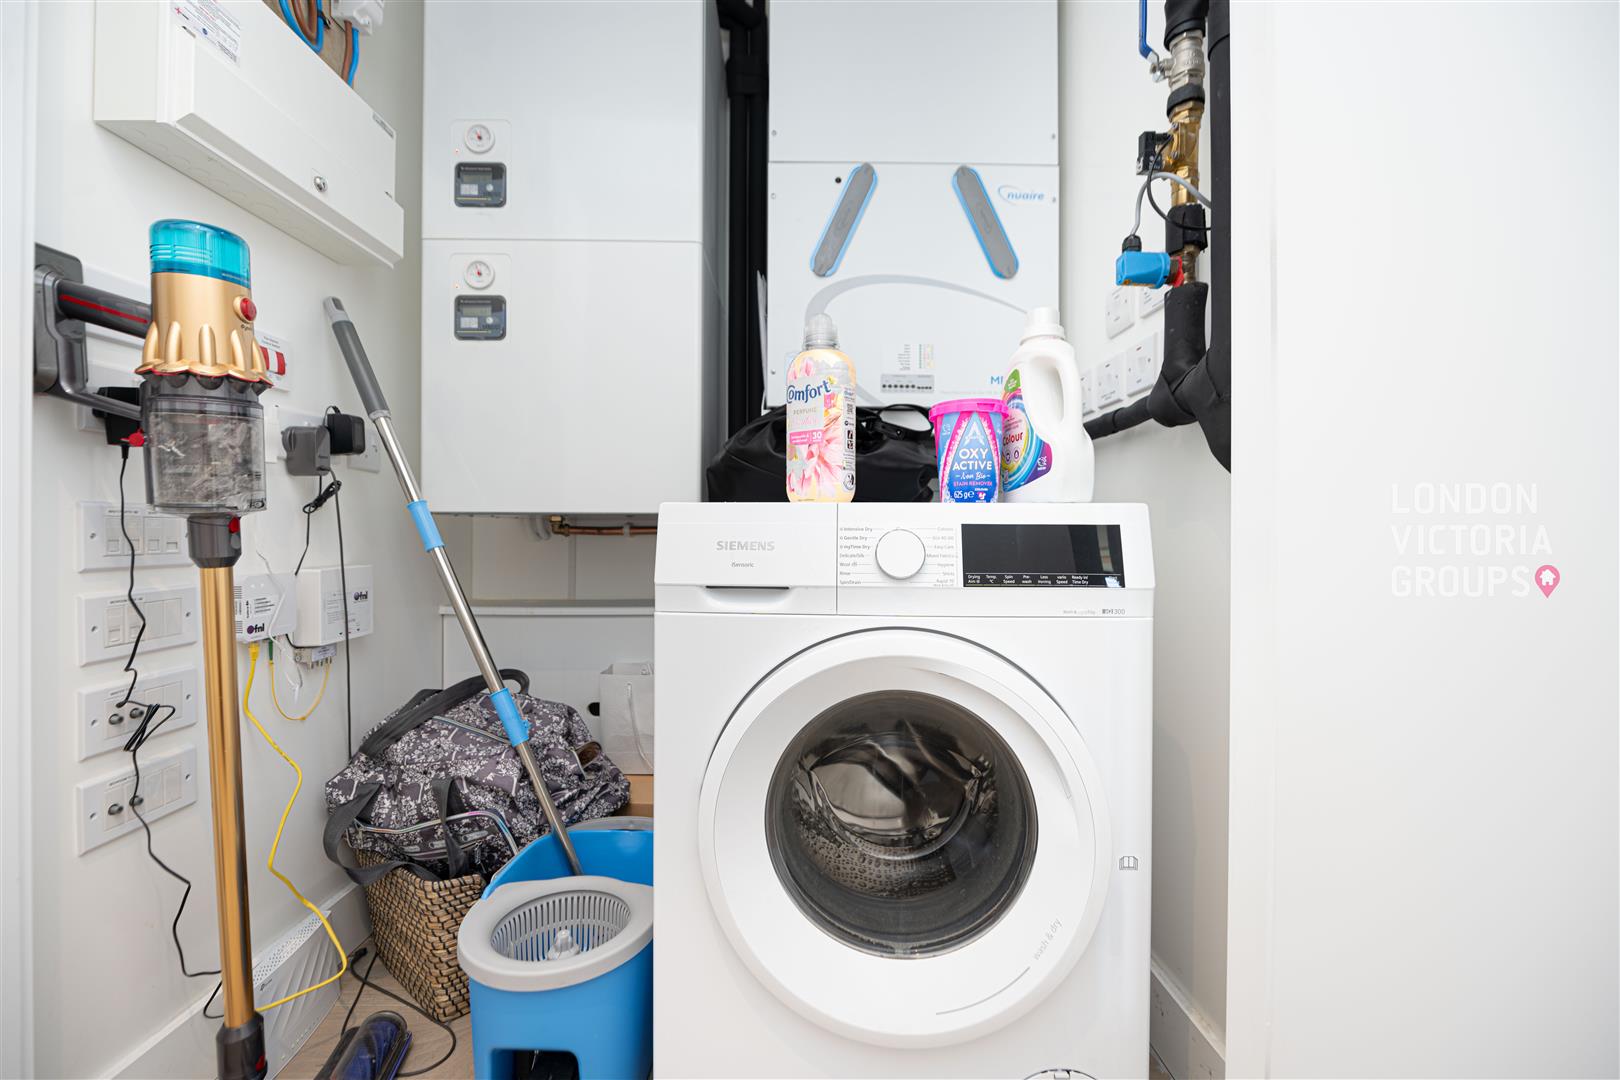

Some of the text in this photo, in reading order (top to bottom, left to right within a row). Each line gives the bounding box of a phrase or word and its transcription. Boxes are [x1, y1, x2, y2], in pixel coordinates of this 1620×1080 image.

[1007, 190, 1045, 201] nuaire
[786, 380, 832, 404] Comfort
[958, 448, 989, 460] OXY
[952, 460, 993, 470] ACTIVE
[716, 540, 776, 551] SIEMENS
